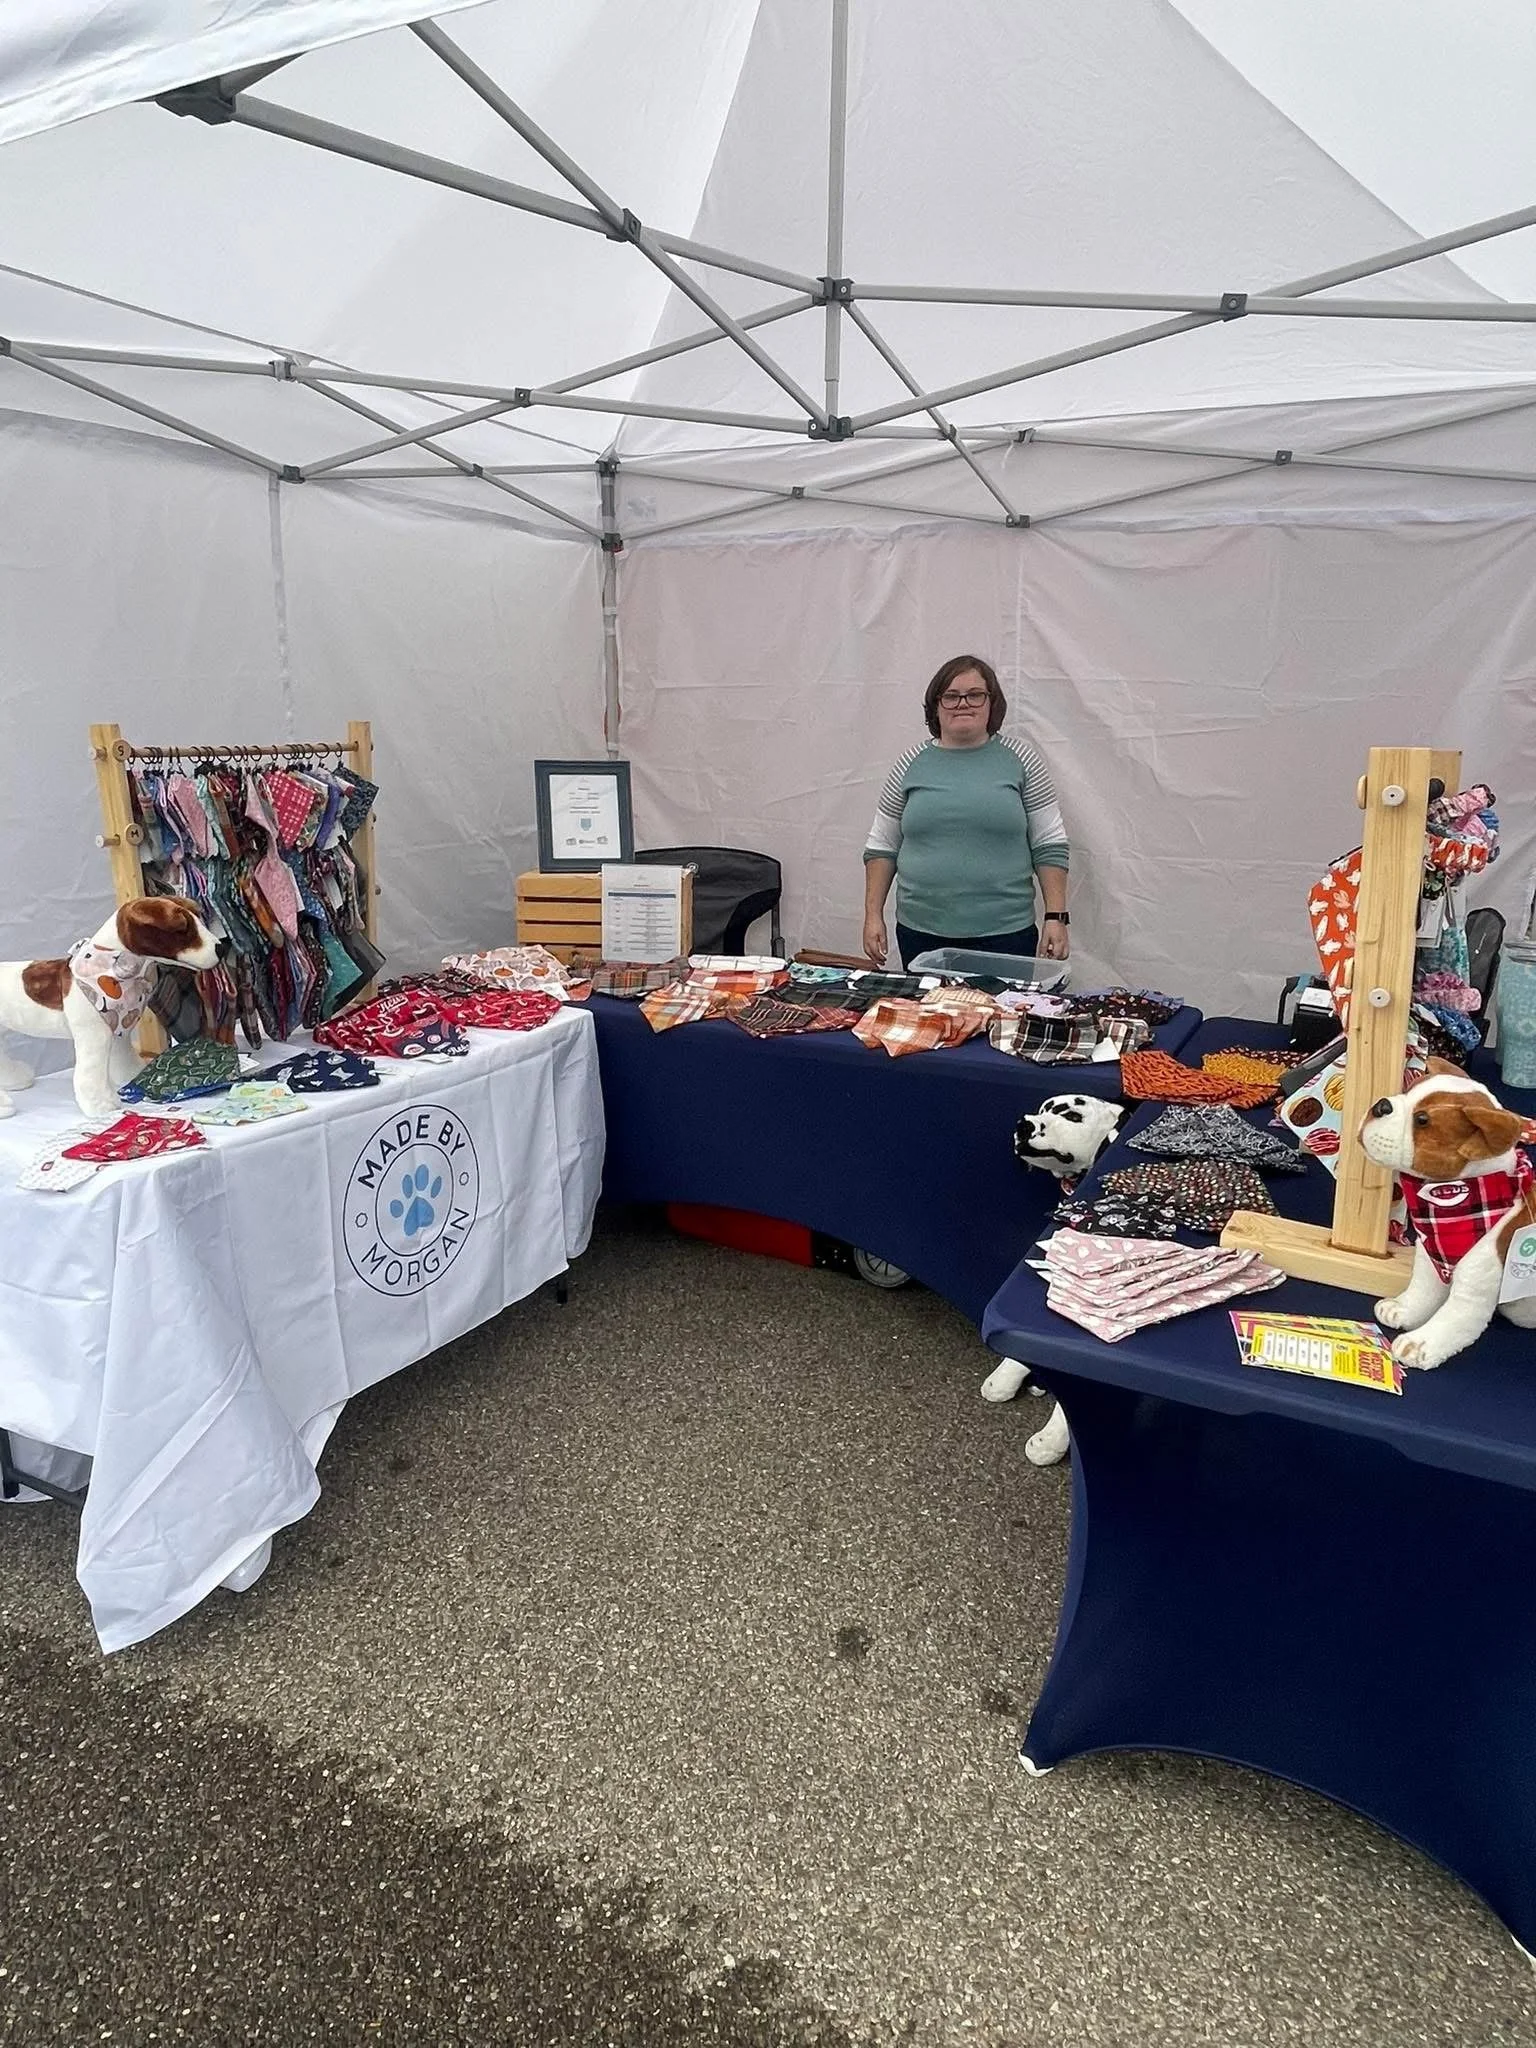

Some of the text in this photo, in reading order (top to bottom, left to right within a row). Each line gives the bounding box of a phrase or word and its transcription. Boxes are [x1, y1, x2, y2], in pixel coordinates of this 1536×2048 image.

[358, 1115, 466, 1189] MADE BY
[361, 1207, 470, 1286] MORGAN
